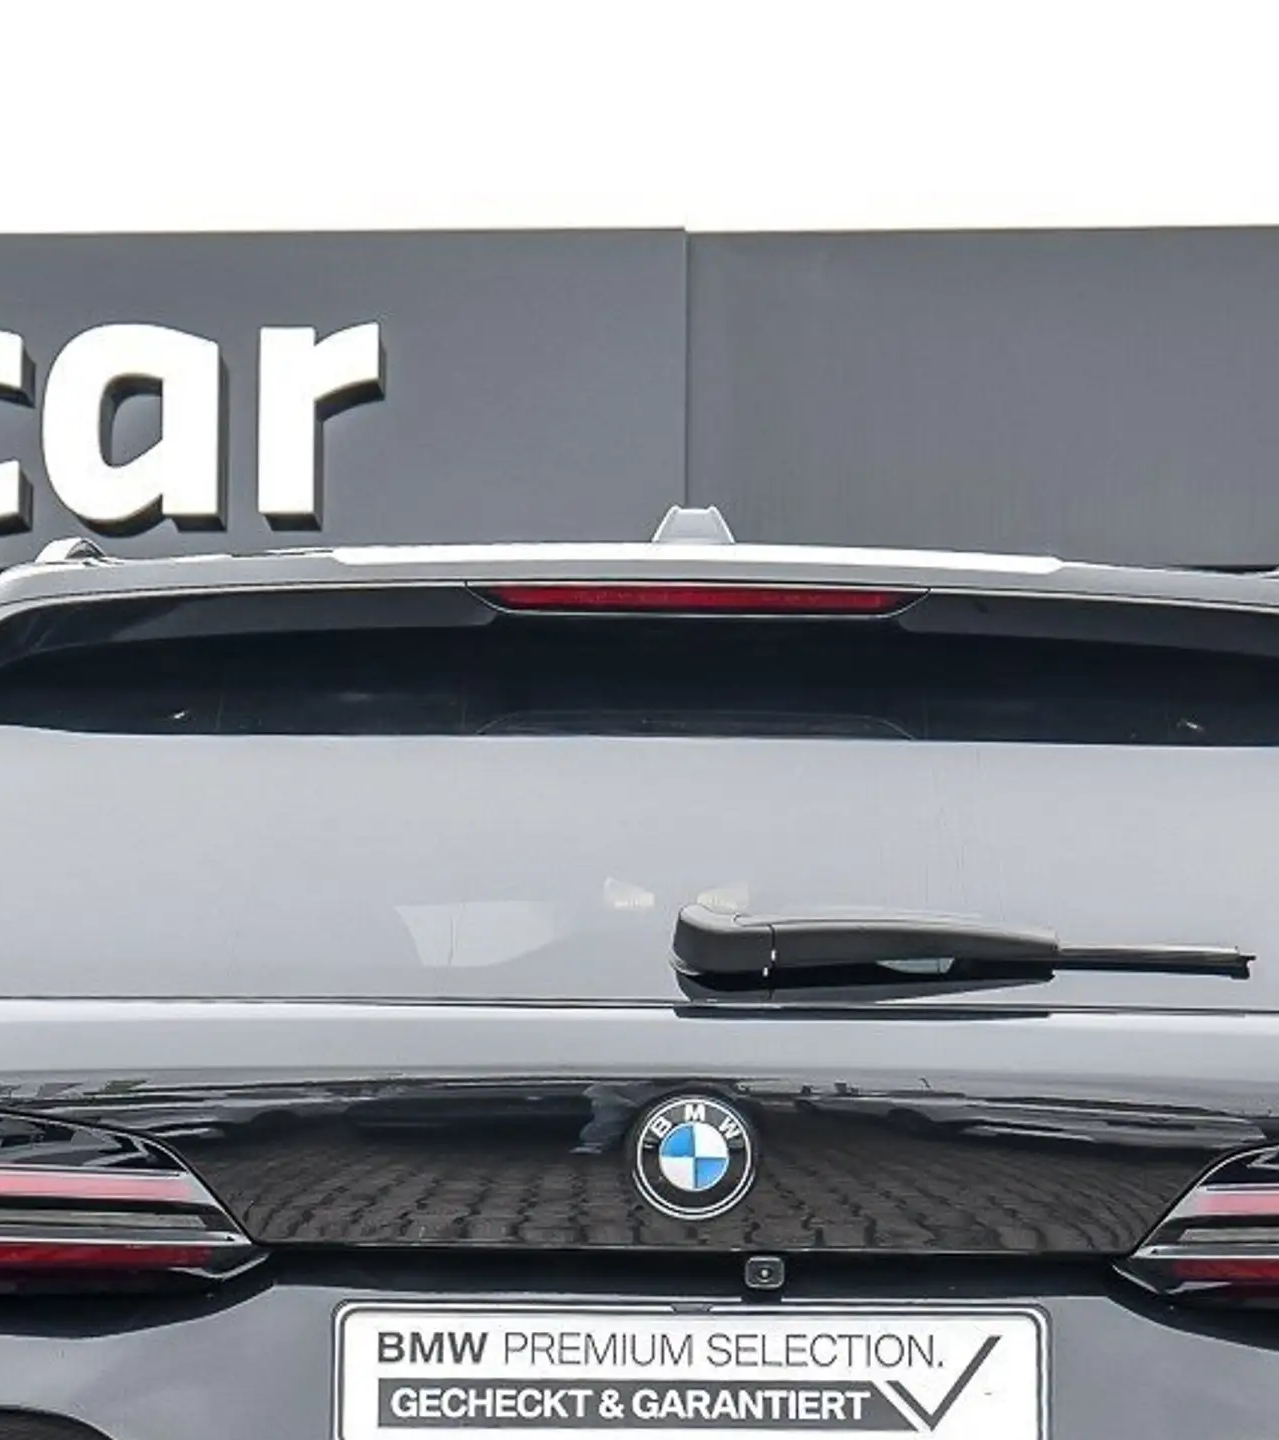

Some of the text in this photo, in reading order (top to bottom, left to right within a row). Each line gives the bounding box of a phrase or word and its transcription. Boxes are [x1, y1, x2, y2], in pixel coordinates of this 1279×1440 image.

[649, 1103, 742, 1139] BMW
[377, 1332, 945, 1369] BMW PREMIUM SELECTION.
[390, 1389, 872, 1420] GECHECKT & GARANTIERT
